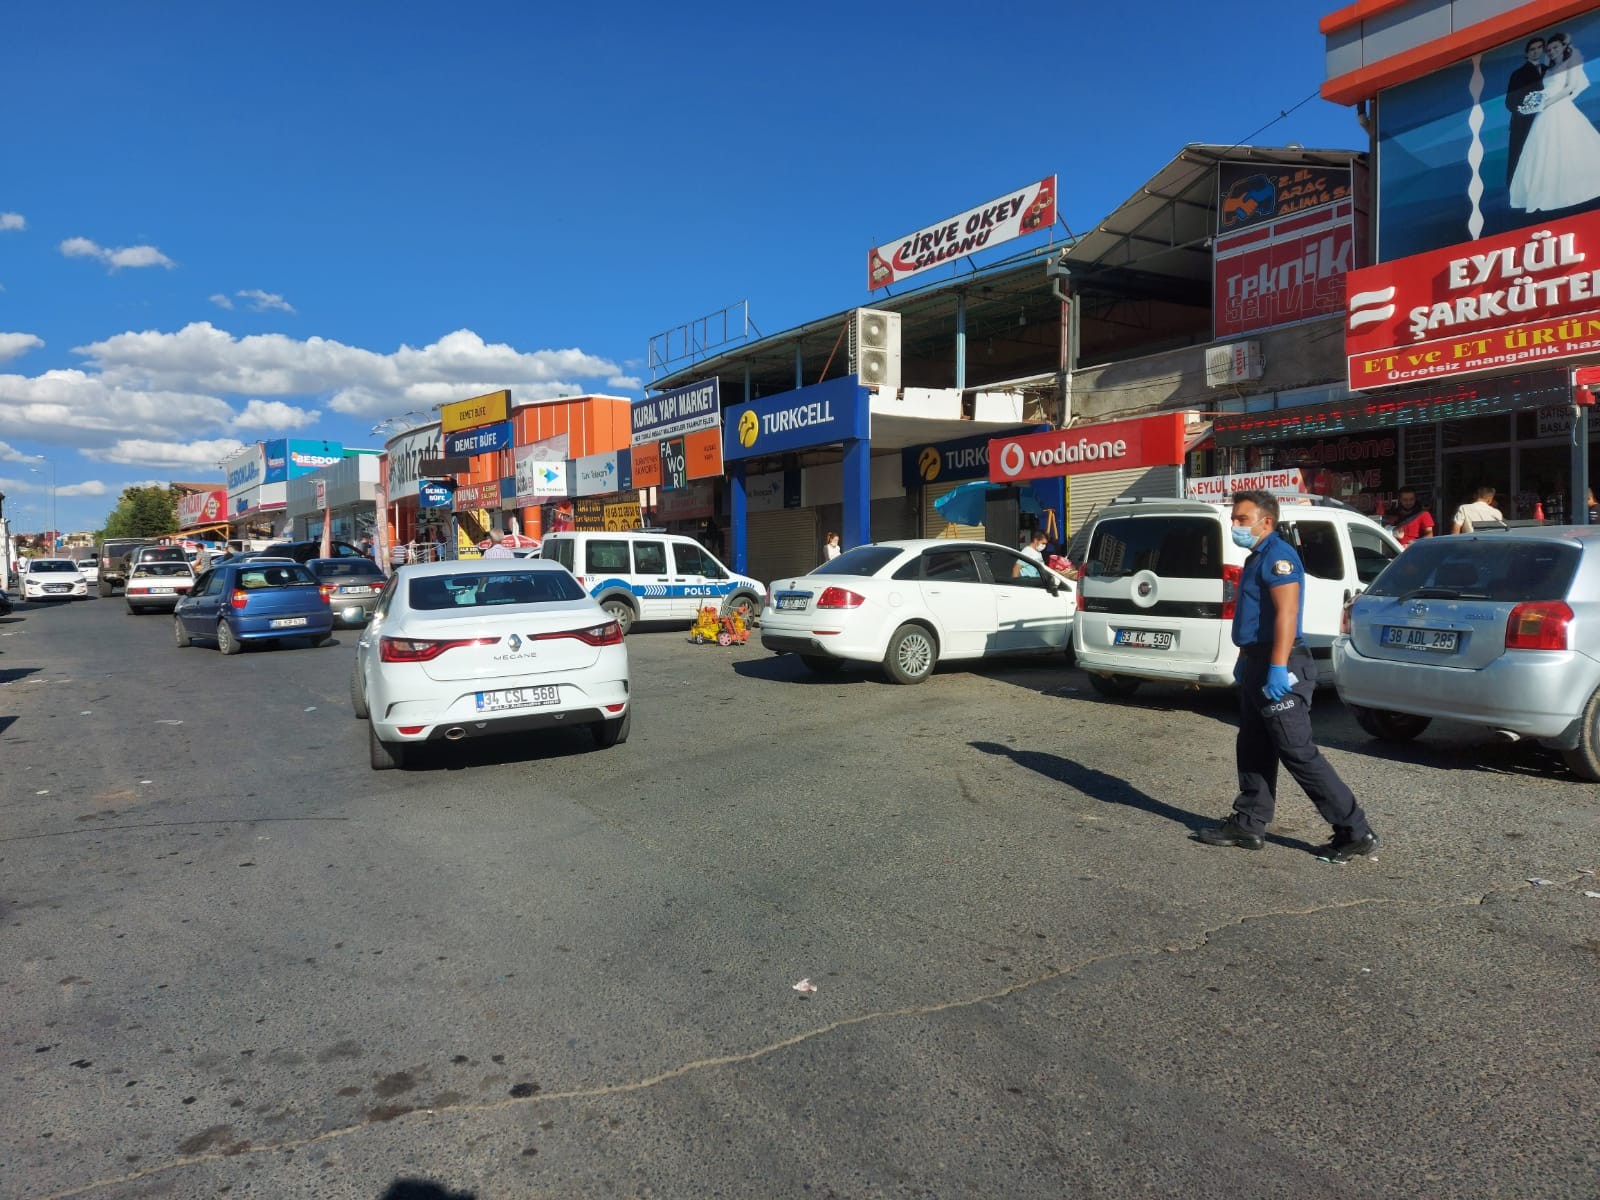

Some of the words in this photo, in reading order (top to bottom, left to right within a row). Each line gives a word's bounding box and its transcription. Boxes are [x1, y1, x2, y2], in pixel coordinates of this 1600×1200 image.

[900, 221, 960, 260] ZİRVE
[965, 194, 1026, 234] OKEY
[912, 228, 993, 271] SALONU
[1448, 229, 1585, 290] EYLÜL
[1226, 236, 1352, 300] Teknik
[1363, 355, 1400, 375] ET
[1408, 349, 1441, 367] ve
[1452, 338, 1493, 359] ET
[1387, 359, 1460, 380] Ücretsiz
[1465, 344, 1560, 368] mangallık
[633, 402, 658, 429] KURAL
[659, 396, 677, 422] YAPI
[679, 385, 714, 416] MARKET
[762, 400, 835, 436] TURKCELL
[455, 436, 479, 452] DEMET
[479, 431, 497, 447] BÜFE
[1029, 438, 1127, 469] vodafone
[1197, 476, 1228, 496] EYLÜL
[1135, 632, 1146, 643] KC
[1153, 634, 1169, 645] 530
[1388, 629, 1402, 643] 38
[1407, 631, 1426, 646] ADL
[1432, 634, 1455, 649] 285
[484, 692, 499, 705] 34
[504, 690, 528, 704] CSL
[533, 687, 555, 701] 568
